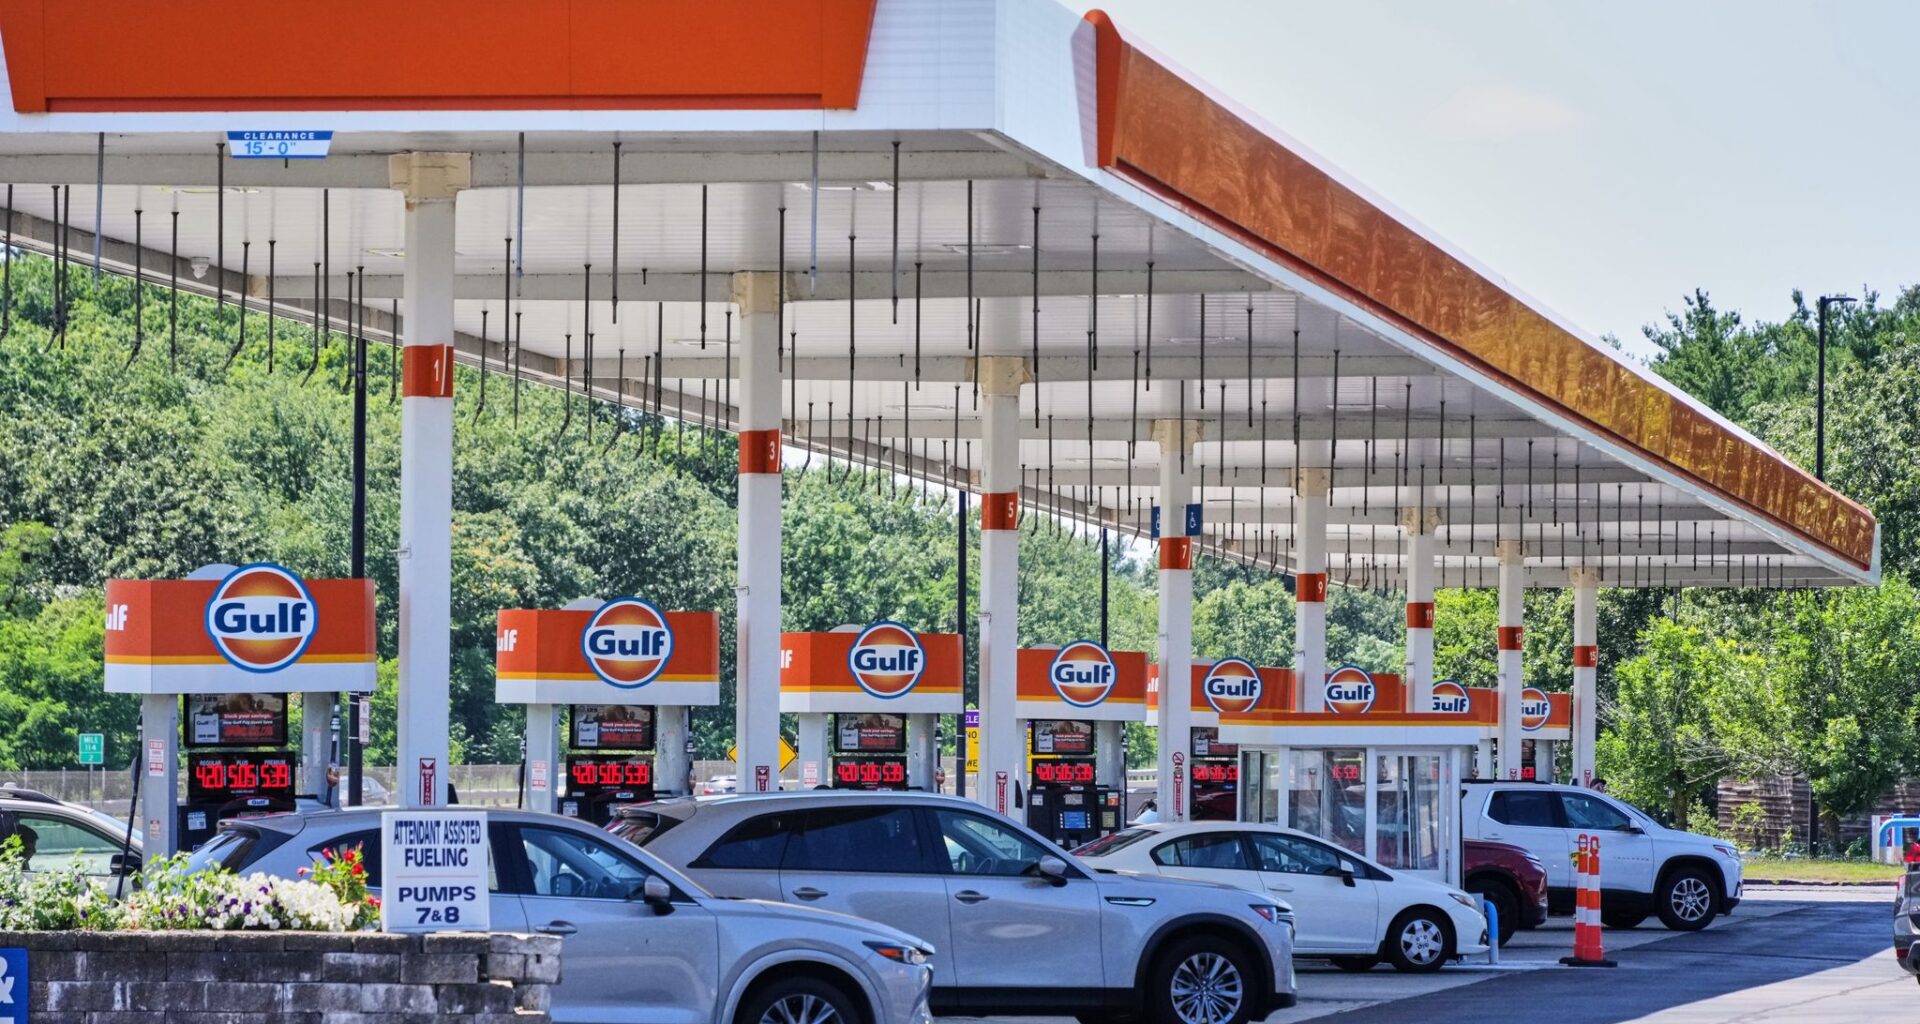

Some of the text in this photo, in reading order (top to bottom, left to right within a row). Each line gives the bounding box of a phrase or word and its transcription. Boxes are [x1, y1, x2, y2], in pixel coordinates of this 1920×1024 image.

[243, 132, 315, 140] CLEARANCE
[433, 358, 440, 382] 1
[769, 440, 776, 460] 3
[1007, 501, 1014, 518] 5
[1182, 544, 1188, 560] 7
[1318, 580, 1324, 594] 9
[214, 602, 307, 633] Gulf
[1425, 609, 1433, 621] 11
[588, 629, 666, 656] Gulf
[854, 648, 919, 671] Gulf
[1054, 663, 1111, 683] Gulf
[1207, 678, 1258, 697] Gulf
[1326, 684, 1372, 701] Gulf
[1521, 702, 1548, 716] ulf
[394, 820, 481, 845] ATTENDANT ASSISTED
[404, 848, 468, 867] FUELING
[398, 886, 476, 903] PUMPS
[415, 906, 460, 925] 7&8
